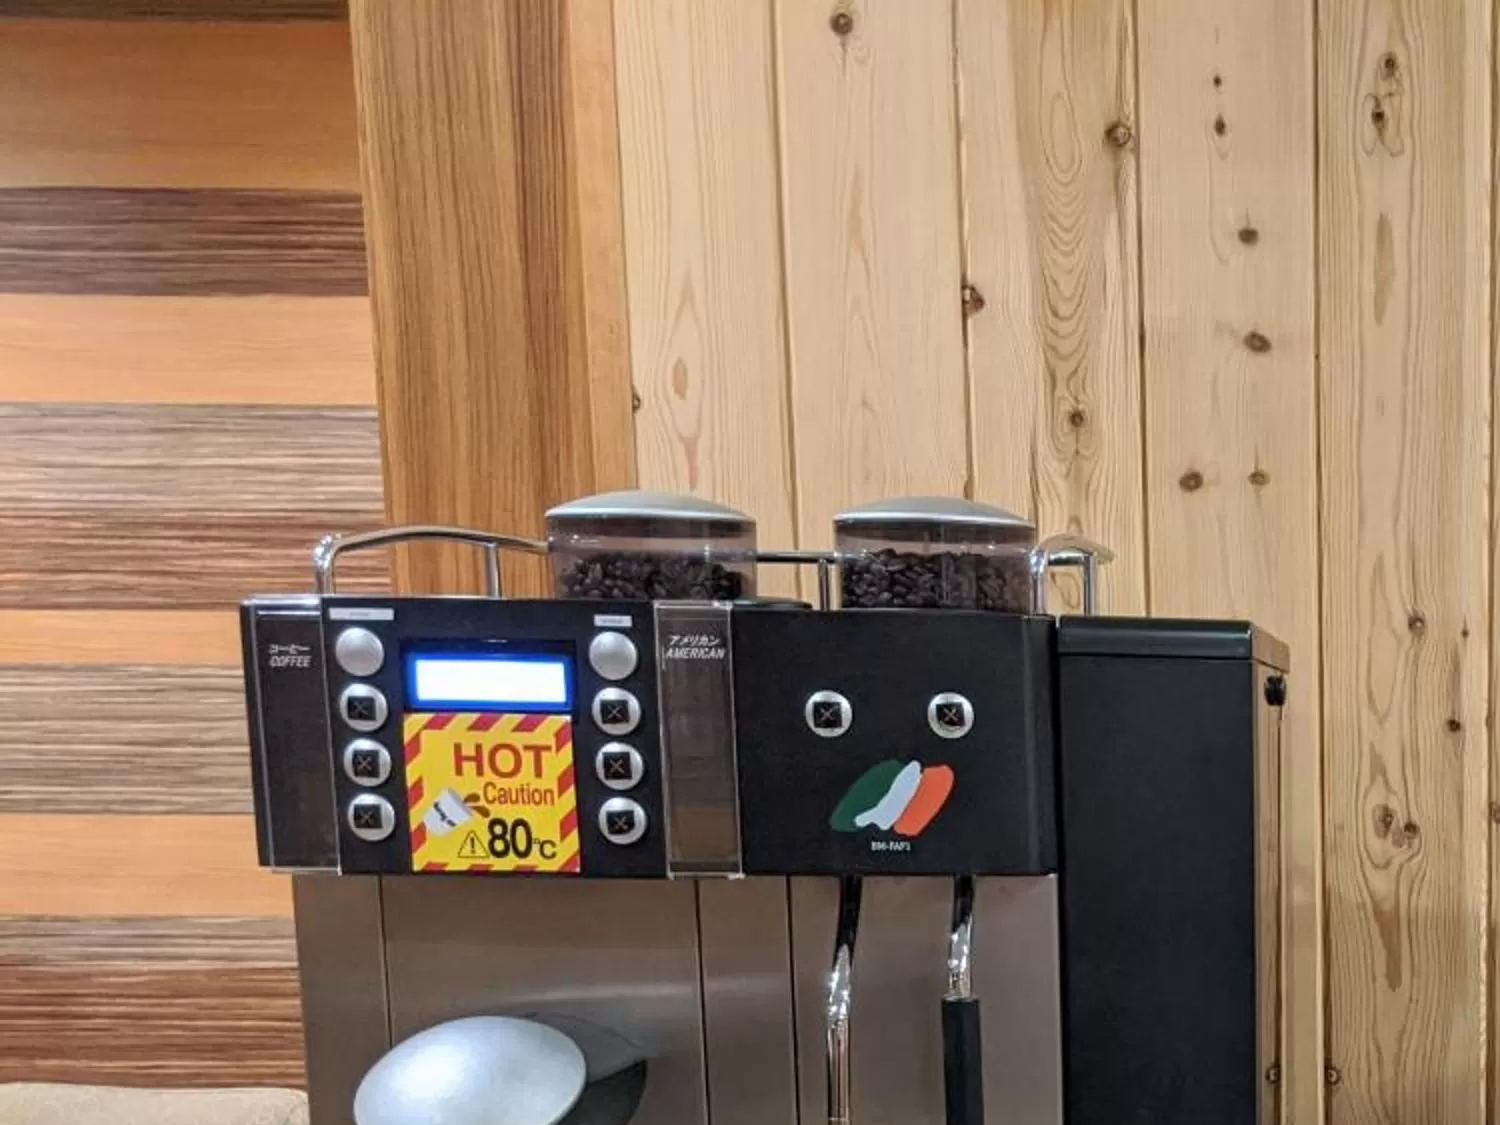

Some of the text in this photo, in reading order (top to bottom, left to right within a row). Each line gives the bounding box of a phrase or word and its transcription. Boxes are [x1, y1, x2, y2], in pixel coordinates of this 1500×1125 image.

[668, 634, 720, 646] アメリカン
[268, 644, 311, 655] コーヒー
[665, 648, 726, 660] AMERICAN
[269, 655, 312, 668] COFFEE
[453, 742, 553, 779] HOT
[482, 781, 556, 806] Caution
